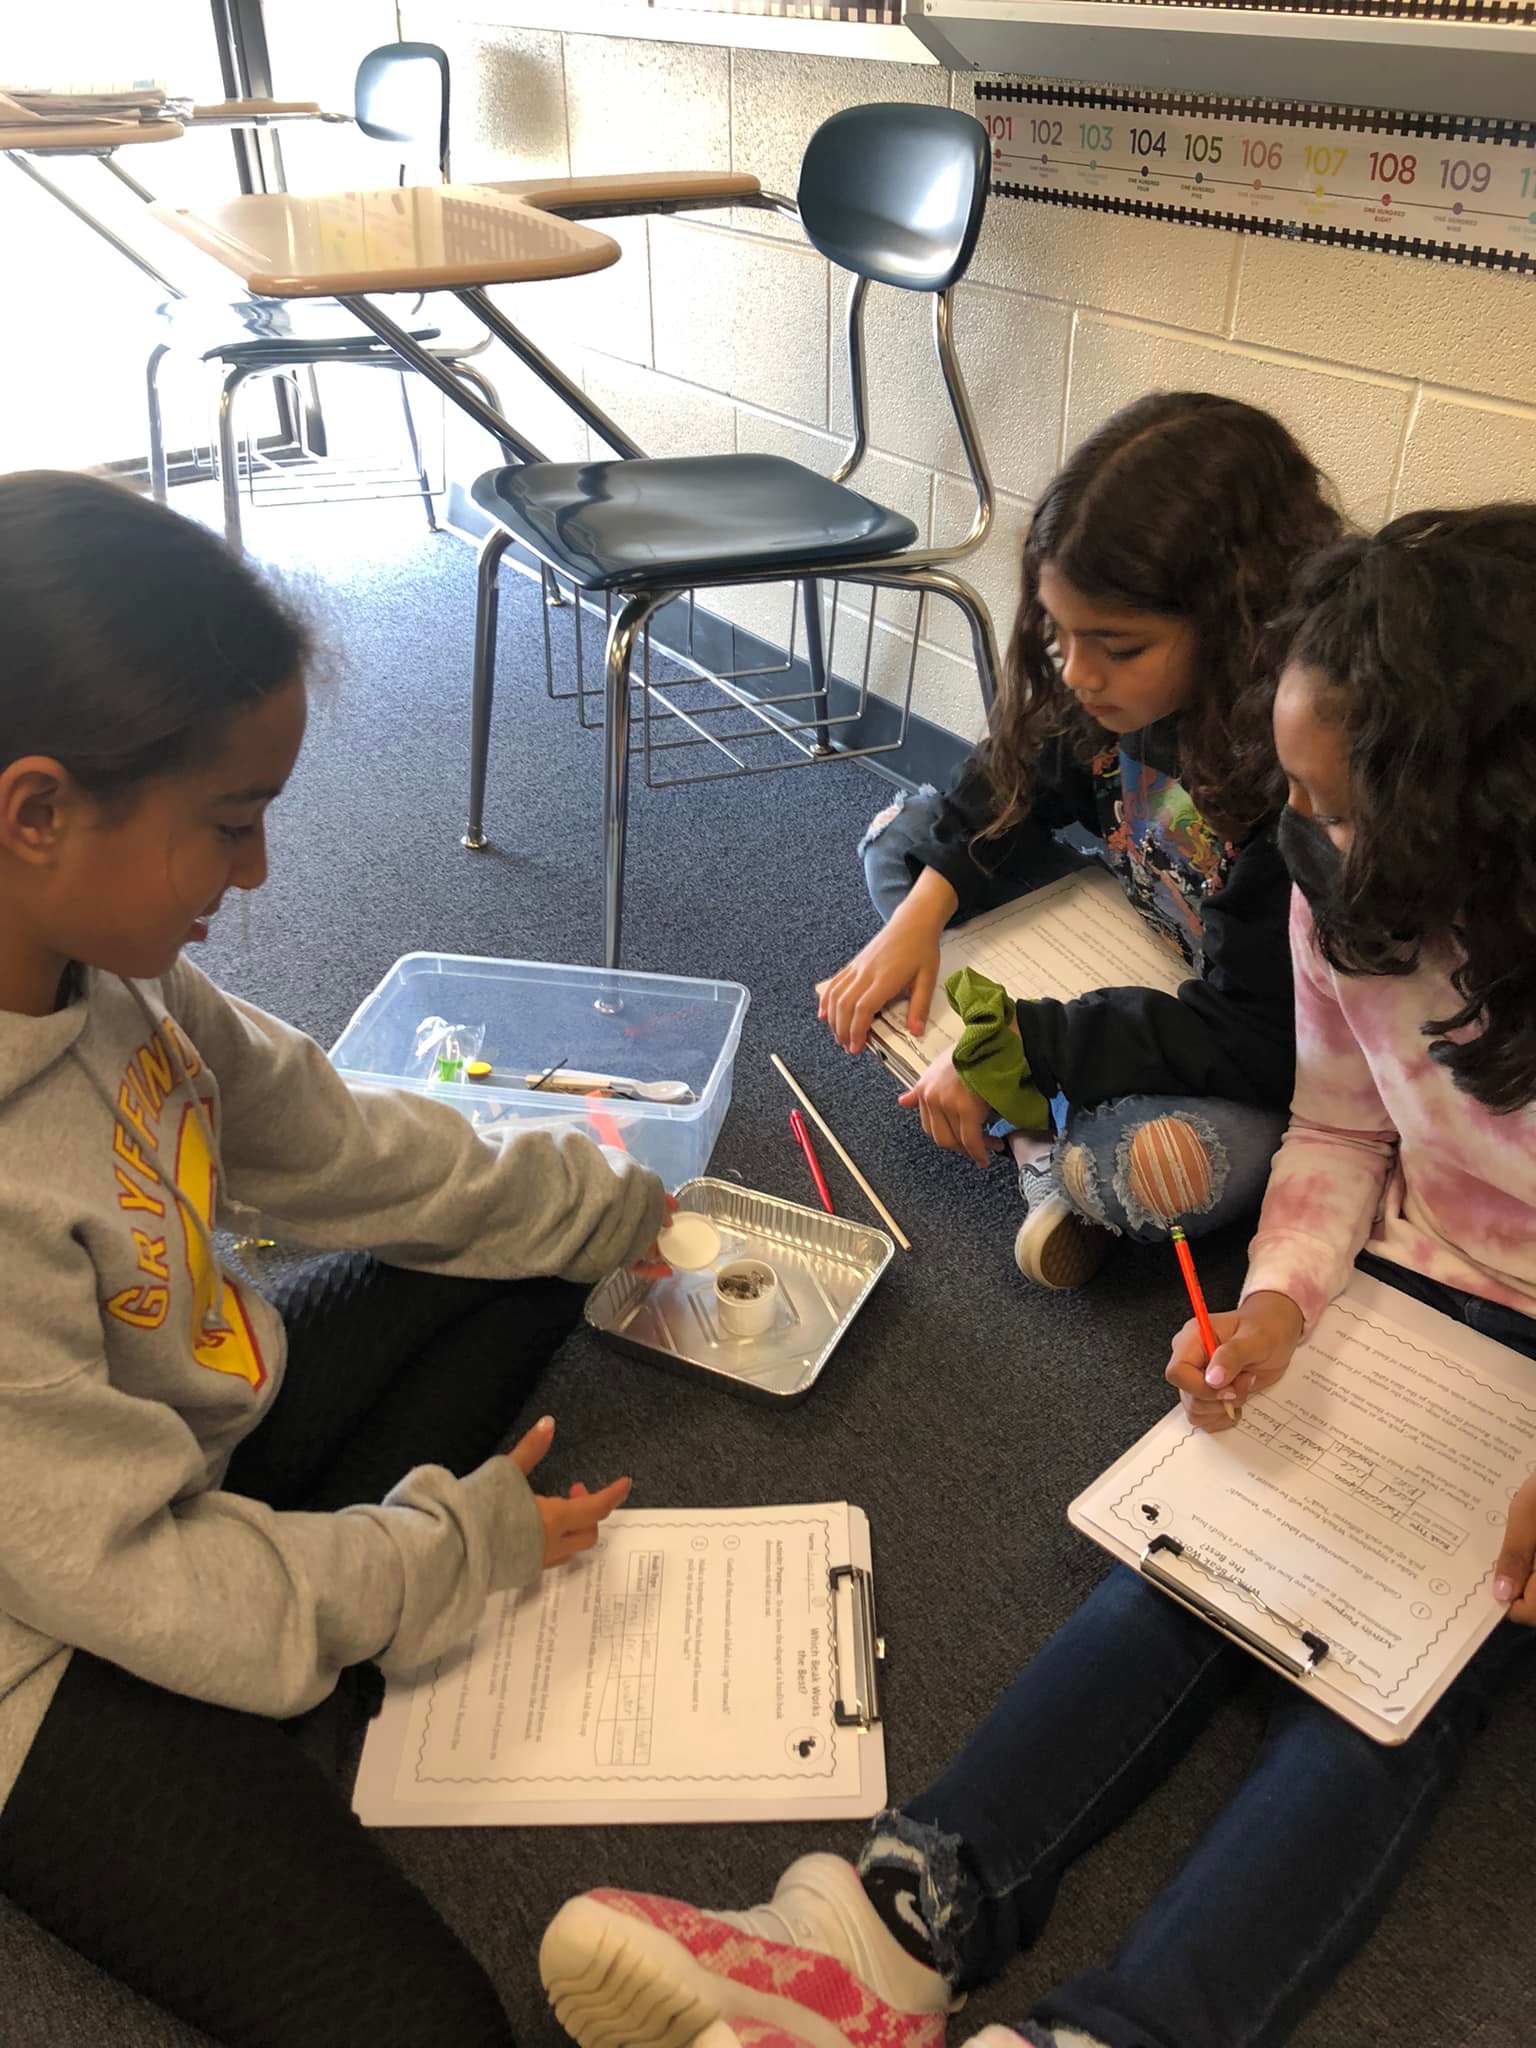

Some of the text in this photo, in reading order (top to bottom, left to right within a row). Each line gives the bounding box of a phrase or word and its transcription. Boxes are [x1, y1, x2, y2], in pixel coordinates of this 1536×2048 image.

[985, 115, 1012, 141] 101
[1031, 119, 1063, 146] 102
[1079, 123, 1113, 151] 103
[1130, 128, 1168, 157] 104
[1185, 133, 1223, 164] 105
[1241, 138, 1283, 170] 106
[1304, 144, 1349, 177] 107
[1369, 151, 1417, 185] 108
[1440, 159, 1492, 193] 109
[1198, 1540, 1246, 1575] the Best?
[797, 1650, 807, 1694] the Best?
[810, 1627, 821, 1716] Which Beak Works
